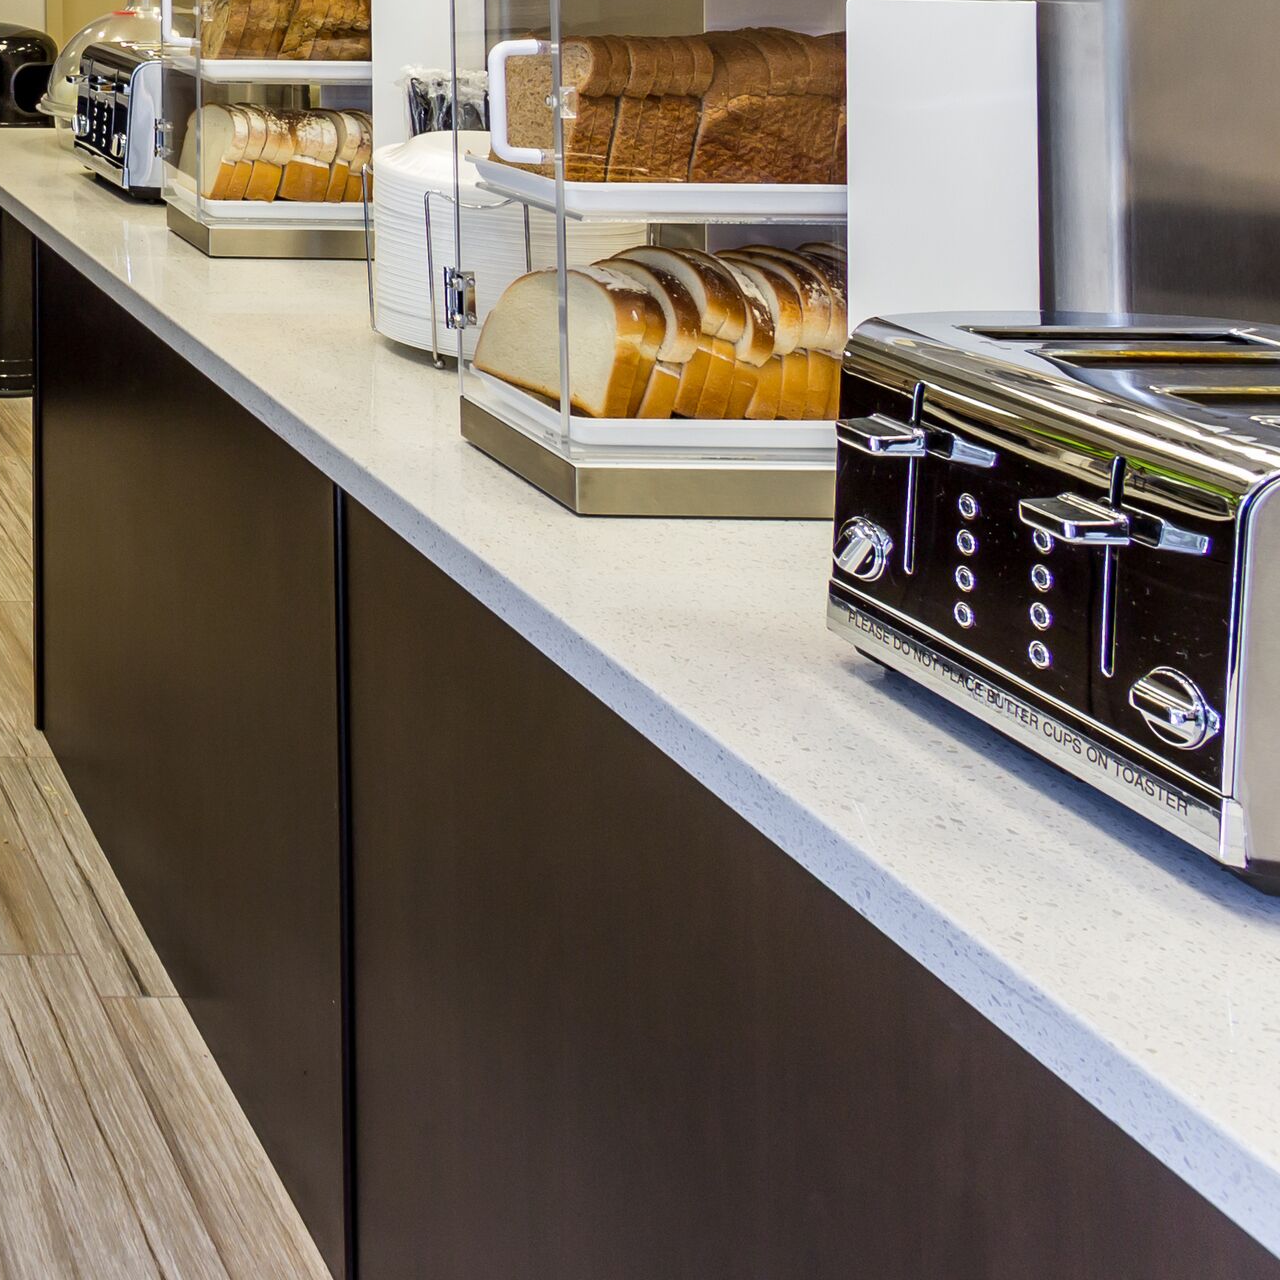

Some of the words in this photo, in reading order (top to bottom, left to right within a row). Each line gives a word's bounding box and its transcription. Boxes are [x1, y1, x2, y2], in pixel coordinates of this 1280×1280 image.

[847, 608, 890, 646] PLEASE
[892, 633, 912, 656] DO
[912, 645, 939, 673] NOT
[941, 658, 983, 699] PLACE
[986, 682, 1040, 731] BUTTER
[1042, 719, 1083, 756] CUPS
[1086, 743, 1109, 771] ON
[1113, 759, 1189, 818] TOASTER
